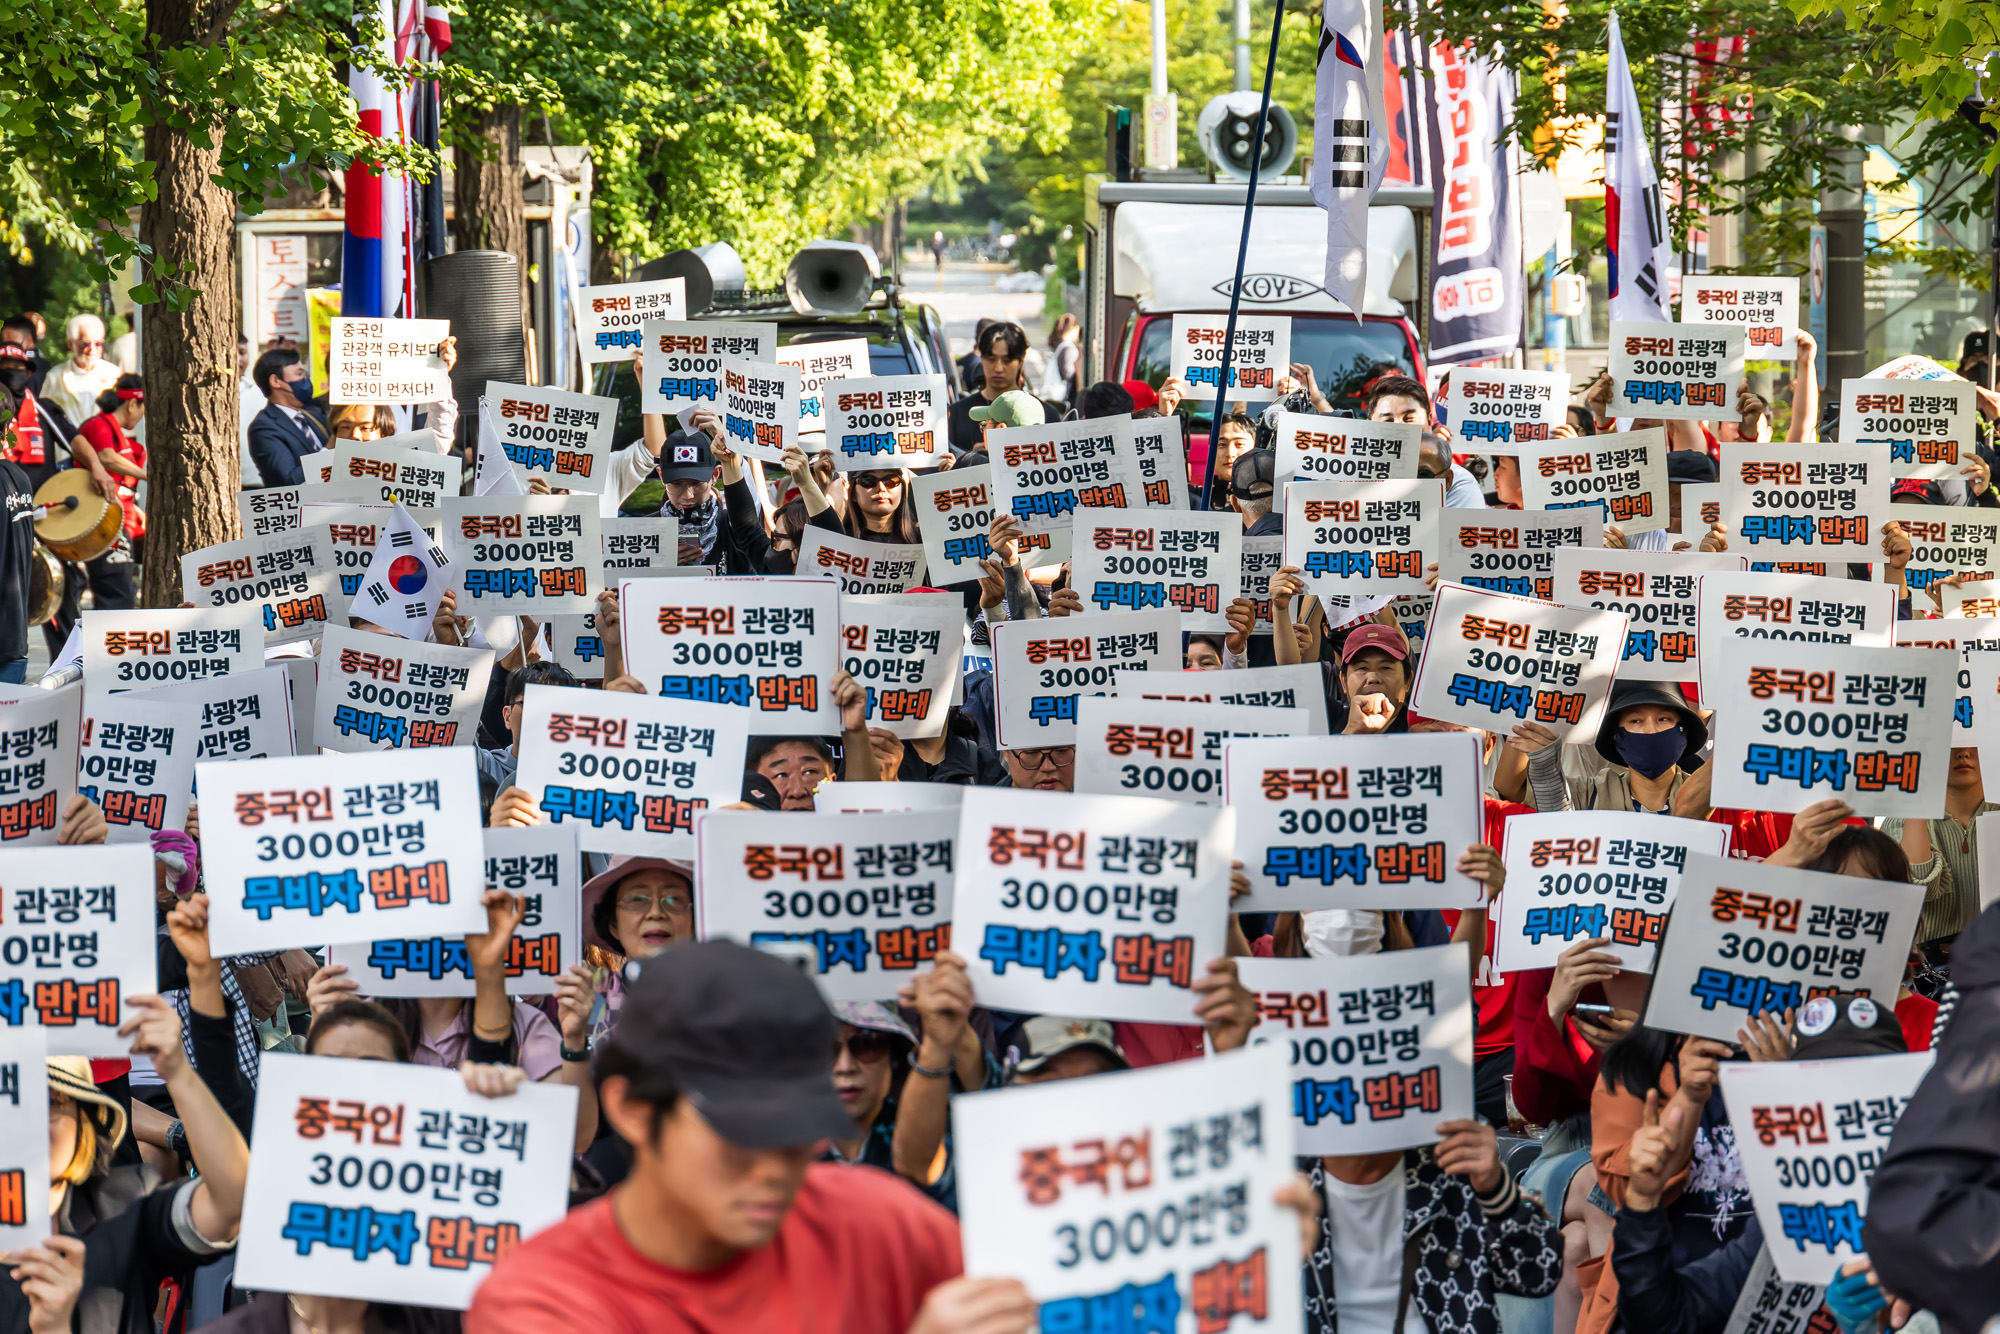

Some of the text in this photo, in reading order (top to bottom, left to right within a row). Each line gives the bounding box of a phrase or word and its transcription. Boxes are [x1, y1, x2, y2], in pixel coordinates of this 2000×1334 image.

[266, 239, 300, 336] 토스트
[1696, 290, 1782, 305] 중국인 관광객
[592, 292, 671, 312] 중국인 관광객
[1704, 309, 1775, 322] 3000만명
[342, 323, 383, 338] 중국인
[596, 330, 641, 349] 무비자
[659, 334, 759, 354] 중국인 관광객
[1234, 329, 1274, 346] 관광객
[1749, 328, 1782, 346] 반대
[341, 342, 441, 358] 관광객 유치보다
[1624, 337, 1727, 358] 중국인 관광객
[341, 362, 381, 376] 자국민
[810, 354, 852, 373] 관광객
[341, 382, 433, 396] 안전이 먼저다!
[660, 378, 718, 401] 무비자
[725, 371, 784, 399] 중국인 관광객
[1239, 368, 1273, 389] 반대
[1462, 381, 1551, 400] 중국인 관광객
[728, 394, 776, 420] 3000만명
[838, 389, 932, 411] 중국인 관광객
[1624, 380, 1726, 406] 무비자 반대
[1855, 394, 1958, 414] 중국인 관광객
[501, 398, 599, 429] 중국인 관광객
[847, 411, 924, 429] 3000만명
[1469, 402, 1542, 418] 3000만명
[507, 422, 588, 448] 3000만명
[725, 414, 754, 444] 무비자
[1461, 421, 1549, 442] 무비자 반대
[1863, 418, 1949, 436] 3000만명
[841, 431, 934, 457] 무비자 반대
[1003, 434, 1116, 467] 중국인 관광객
[1350, 437, 1402, 459] 관광객
[1918, 441, 1958, 465] 반대
[400, 466, 446, 489] 관광객
[556, 453, 592, 478] 반대
[1016, 459, 1109, 488] 3000만명
[1301, 456, 1391, 479] 3000만명
[1538, 454, 1593, 476] 중국인
[1740, 461, 1868, 485] 중국인 관광객
[933, 484, 988, 511] 중국인
[1549, 470, 1641, 497] 3000만명
[250, 490, 299, 513] 중국인
[1012, 490, 1078, 520] 무비자
[1304, 501, 1421, 522] 중국인 관광객
[1610, 492, 1653, 522] 반대
[1752, 489, 1857, 510] 3000만명
[461, 514, 582, 538] 중국인 관광객
[1093, 528, 1220, 552] 중국인 관광객
[1314, 526, 1411, 544] 3000만명
[1459, 526, 1582, 549] 중국인 관광객
[1741, 516, 1816, 545] 무비자
[1950, 523, 1998, 544] 관광객
[473, 540, 574, 562] 3000만명
[608, 534, 659, 554] 관광객
[197, 556, 254, 588] 중국인
[257, 545, 314, 574] 관광객
[817, 546, 869, 577] 중국인
[1104, 556, 1208, 578] 3000만명
[1304, 550, 1422, 578] 무비자 반대
[464, 566, 587, 598] 무비자 반대
[1578, 570, 1645, 598] 중국인
[278, 594, 328, 623] 반대
[1092, 581, 1166, 611] 무비자
[1170, 584, 1219, 613] 반대
[658, 606, 815, 634] 중국인 관광객
[1723, 594, 1866, 630] 중국인 관광객
[105, 629, 241, 656] 중국인 관광객
[874, 629, 941, 654] 관광객
[1461, 614, 1531, 651] 중국인
[672, 641, 803, 668] 3000만명
[1026, 636, 1092, 664] 중국인
[406, 662, 469, 690] 관광객
[1467, 648, 1582, 686] 3000만명
[347, 681, 454, 716] 3000만명
[758, 674, 818, 712] 반대
[1448, 672, 1586, 725] 무비자 반대
[1748, 666, 1836, 704] 중국인
[1842, 674, 1927, 708] 관광객
[880, 688, 932, 721] 반대
[334, 704, 407, 748] 무비자
[634, 722, 715, 757] 관광객
[1762, 708, 1909, 744] 3000만명
[1106, 723, 1194, 760] 중국인
[558, 752, 696, 789] 3000만명
[1744, 743, 1921, 793] 무비자 반대
[1262, 767, 1350, 801] 중국인
[0, 789, 57, 840] 반대
[102, 789, 166, 829] 반대
[234, 780, 440, 826] 중국인 관광객
[540, 785, 638, 831] 무비자
[1279, 804, 1428, 835] 3000만명
[257, 821, 425, 861] 3000만명
[989, 826, 1198, 879] 중국인 관광객
[1530, 836, 1601, 868] 중국인
[744, 839, 953, 882] 중국인 관광객
[1262, 841, 1446, 886] 무비자 반대
[242, 860, 449, 920] 무비자 반대
[764, 881, 936, 919] 3000만명
[1001, 878, 1179, 924] 3000만명
[1538, 872, 1668, 904] 3000만명
[14, 886, 116, 924] 관광객
[1711, 886, 1889, 944] 중국인 관광객
[1522, 902, 1608, 945] 무비자
[980, 924, 1194, 989] 무비자 반대
[1718, 932, 1866, 980] 3000만명
[35, 977, 120, 1027] 반대
[1338, 981, 1435, 1025] 관광객
[1363, 1065, 1441, 1121] 반대
[294, 1097, 404, 1147] 중국인
[1751, 1101, 1829, 1146] 중국인
[309, 1154, 502, 1208] 3000만명
[282, 1201, 420, 1265] 무비자
[1778, 1201, 1864, 1254] 무비자
